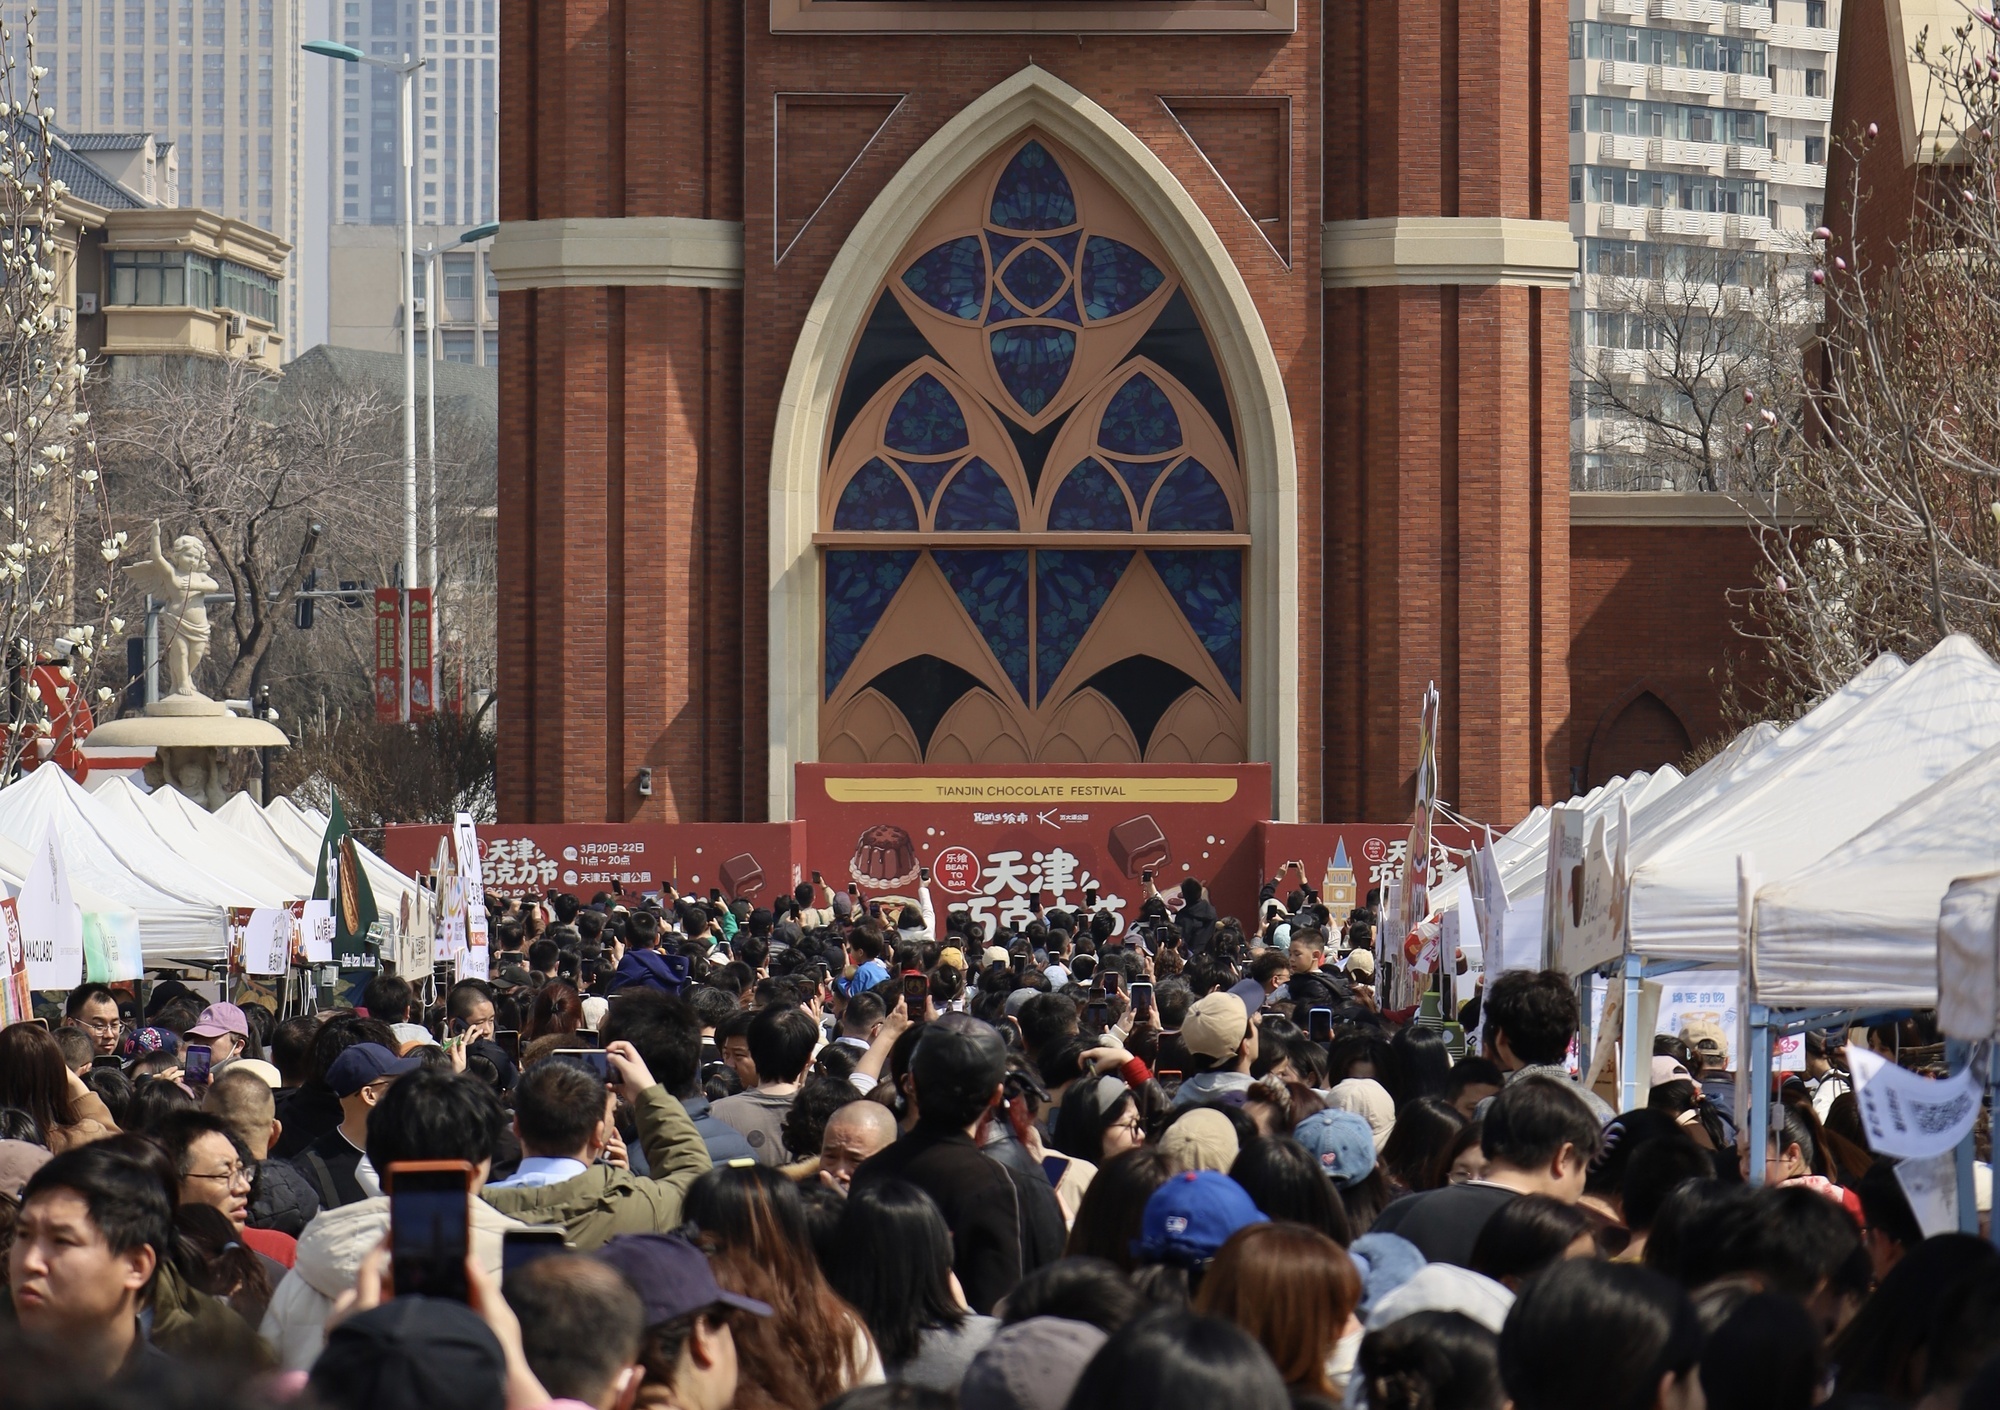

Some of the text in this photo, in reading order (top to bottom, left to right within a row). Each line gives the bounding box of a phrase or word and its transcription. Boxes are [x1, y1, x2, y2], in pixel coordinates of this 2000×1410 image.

[936, 786, 1126, 796] TIANJIN CHOCOLATE FESTIVAL
[488, 838, 535, 862] 天津
[950, 871, 963, 879] TO
[982, 848, 1079, 897] 天津
